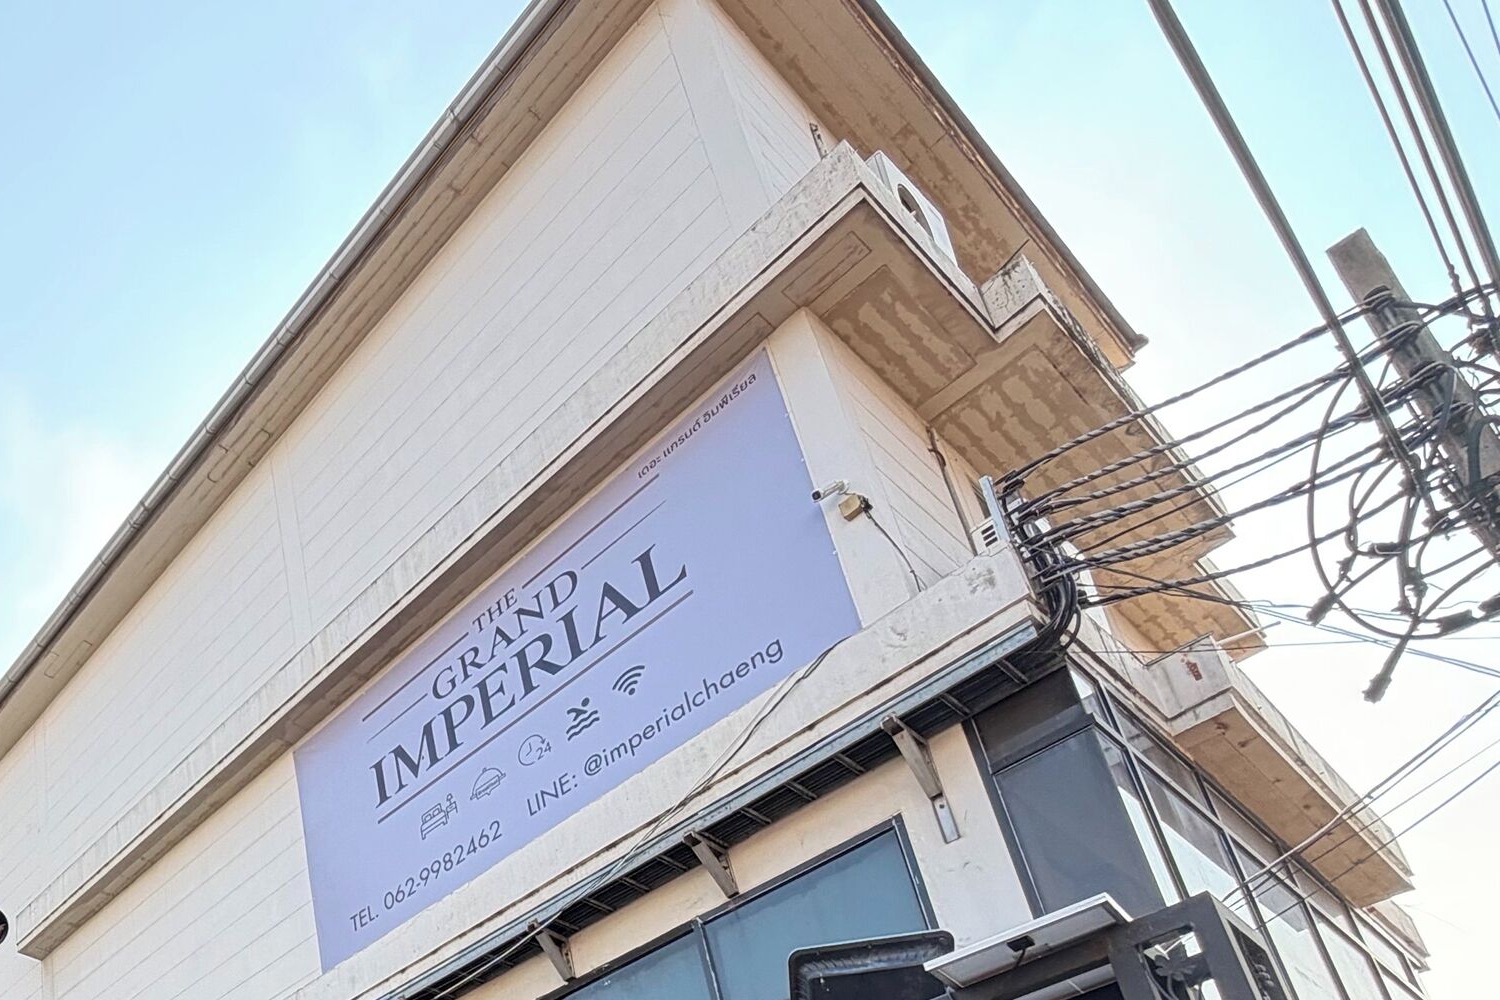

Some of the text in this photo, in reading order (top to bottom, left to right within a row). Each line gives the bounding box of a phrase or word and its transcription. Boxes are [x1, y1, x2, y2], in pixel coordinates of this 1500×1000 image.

[638, 456, 662, 479] เดอะ
[663, 418, 702, 458] แกรนด์
[432, 571, 578, 700] GRAND
[473, 588, 518, 632] THE
[369, 543, 688, 808] IMPERIAL
[350, 638, 784, 932] TEL. 062-9982462 LINE: @imperialchaeng
[536, 741, 552, 760] 24
